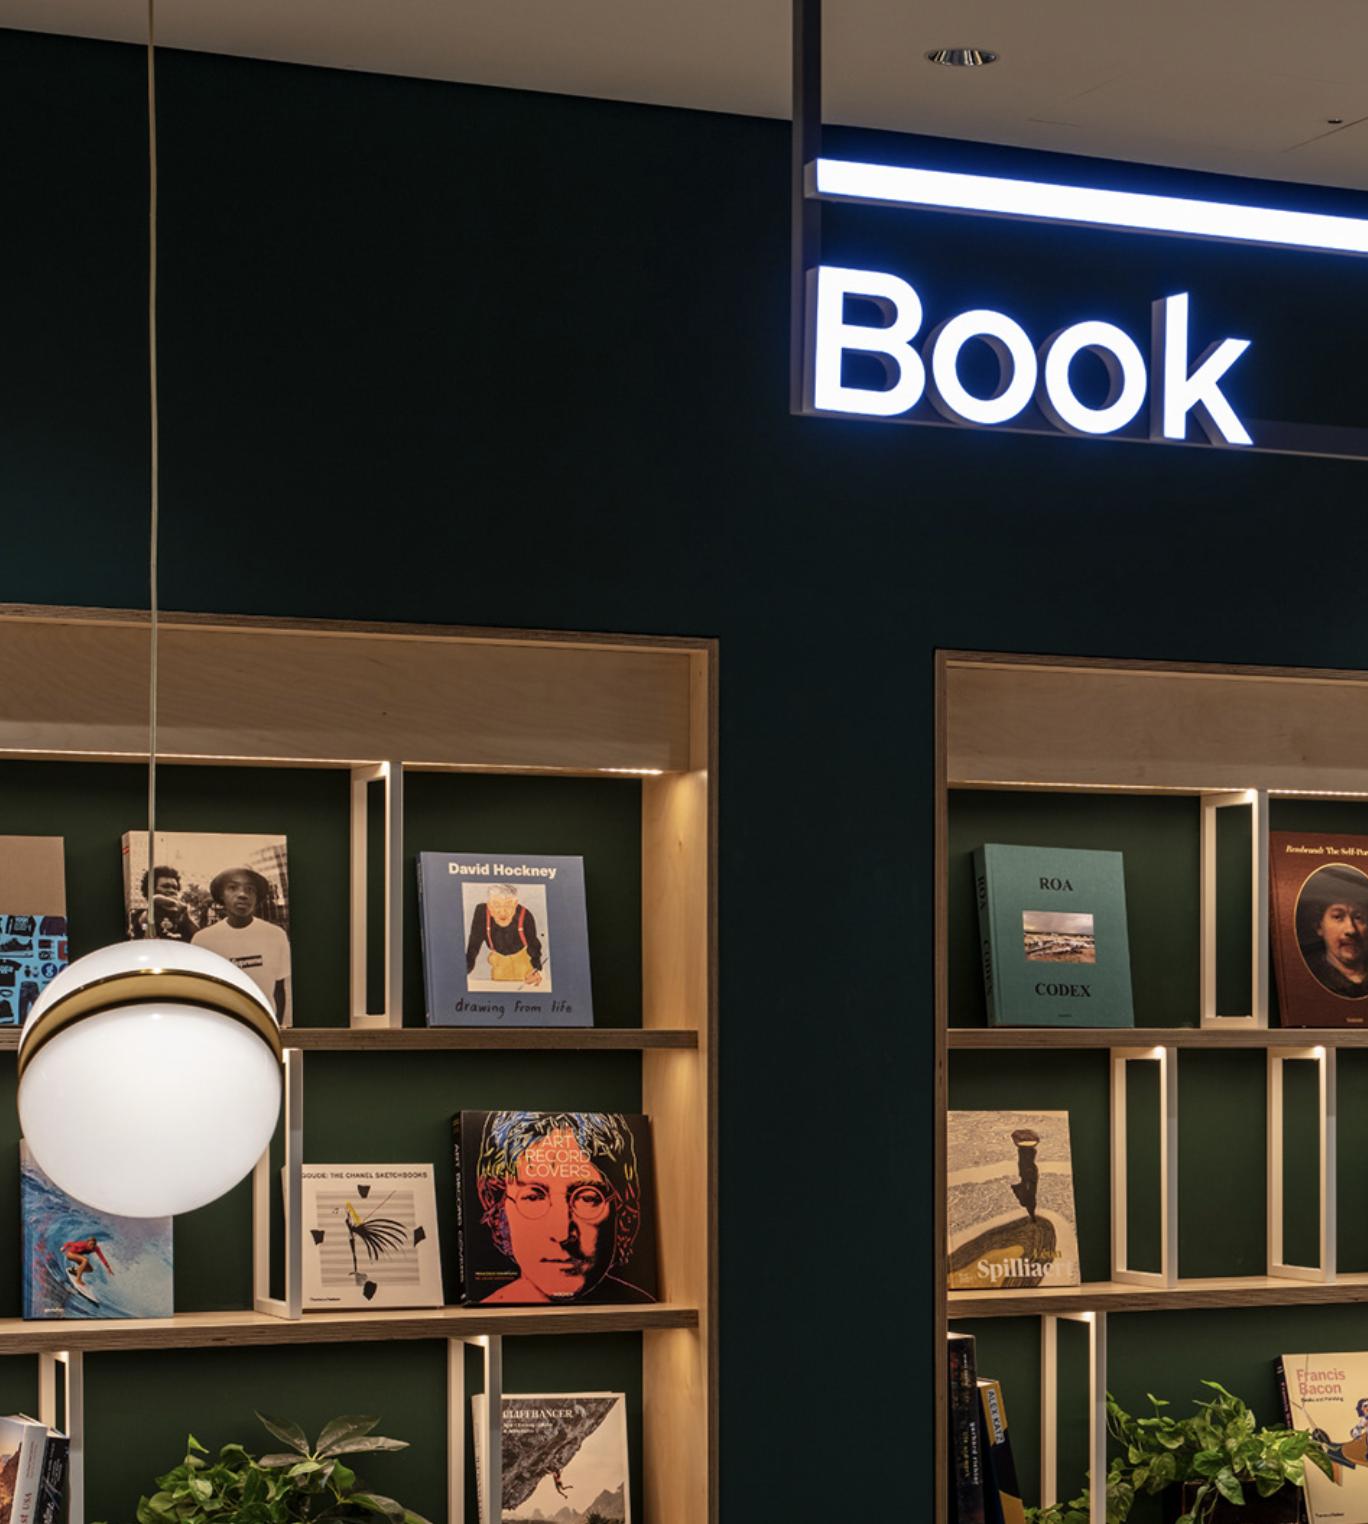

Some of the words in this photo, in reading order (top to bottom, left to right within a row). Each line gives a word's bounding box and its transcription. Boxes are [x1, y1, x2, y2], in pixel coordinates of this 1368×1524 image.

[812, 265, 1254, 445] Book
[1325, 846, 1340, 856] The
[448, 862, 490, 876] David
[493, 864, 557, 879] Hockney
[1039, 877, 1074, 892] ROA
[1034, 982, 1092, 998] CODEX
[455, 998, 505, 1020] drawing
[514, 1001, 542, 1013] from
[551, 1000, 572, 1013] life
[541, 1135, 573, 1148] ART
[525, 1150, 591, 1163] RECORD
[375, 1171, 428, 1179] SKETCHBOOKS
[525, 1164, 591, 1178] COVERS
[455, 1172, 463, 1226] RECORD
[1296, 1368, 1346, 1382] Francis
[1299, 1381, 1342, 1395] Bacon
[988, 1390, 998, 1415] ALEX
[992, 1417, 1004, 1442] KATZ
[969, 1421, 978, 1455] gerhard
[22, 1492, 33, 1510] USA
